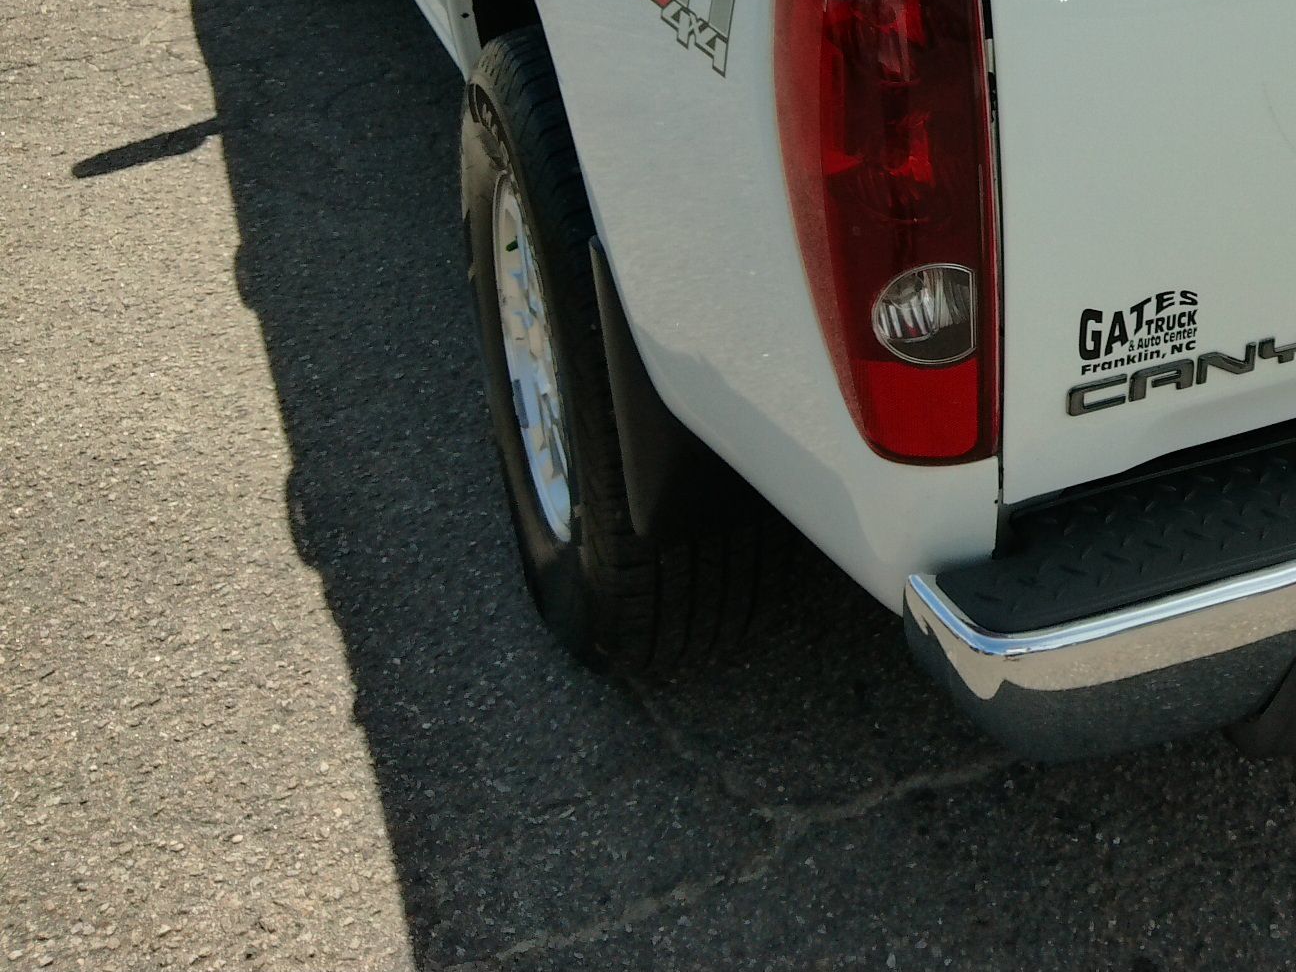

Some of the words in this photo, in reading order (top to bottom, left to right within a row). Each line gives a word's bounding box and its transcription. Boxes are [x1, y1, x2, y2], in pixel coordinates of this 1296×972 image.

[1079, 290, 1199, 361] GATES
[1145, 309, 1199, 336] TRUCK
[1128, 339, 1135, 352] &
[1137, 334, 1162, 350] Auto
[1163, 327, 1198, 344] Center
[1081, 349, 1167, 376] Franklin,
[1170, 340, 1197, 356] NC
